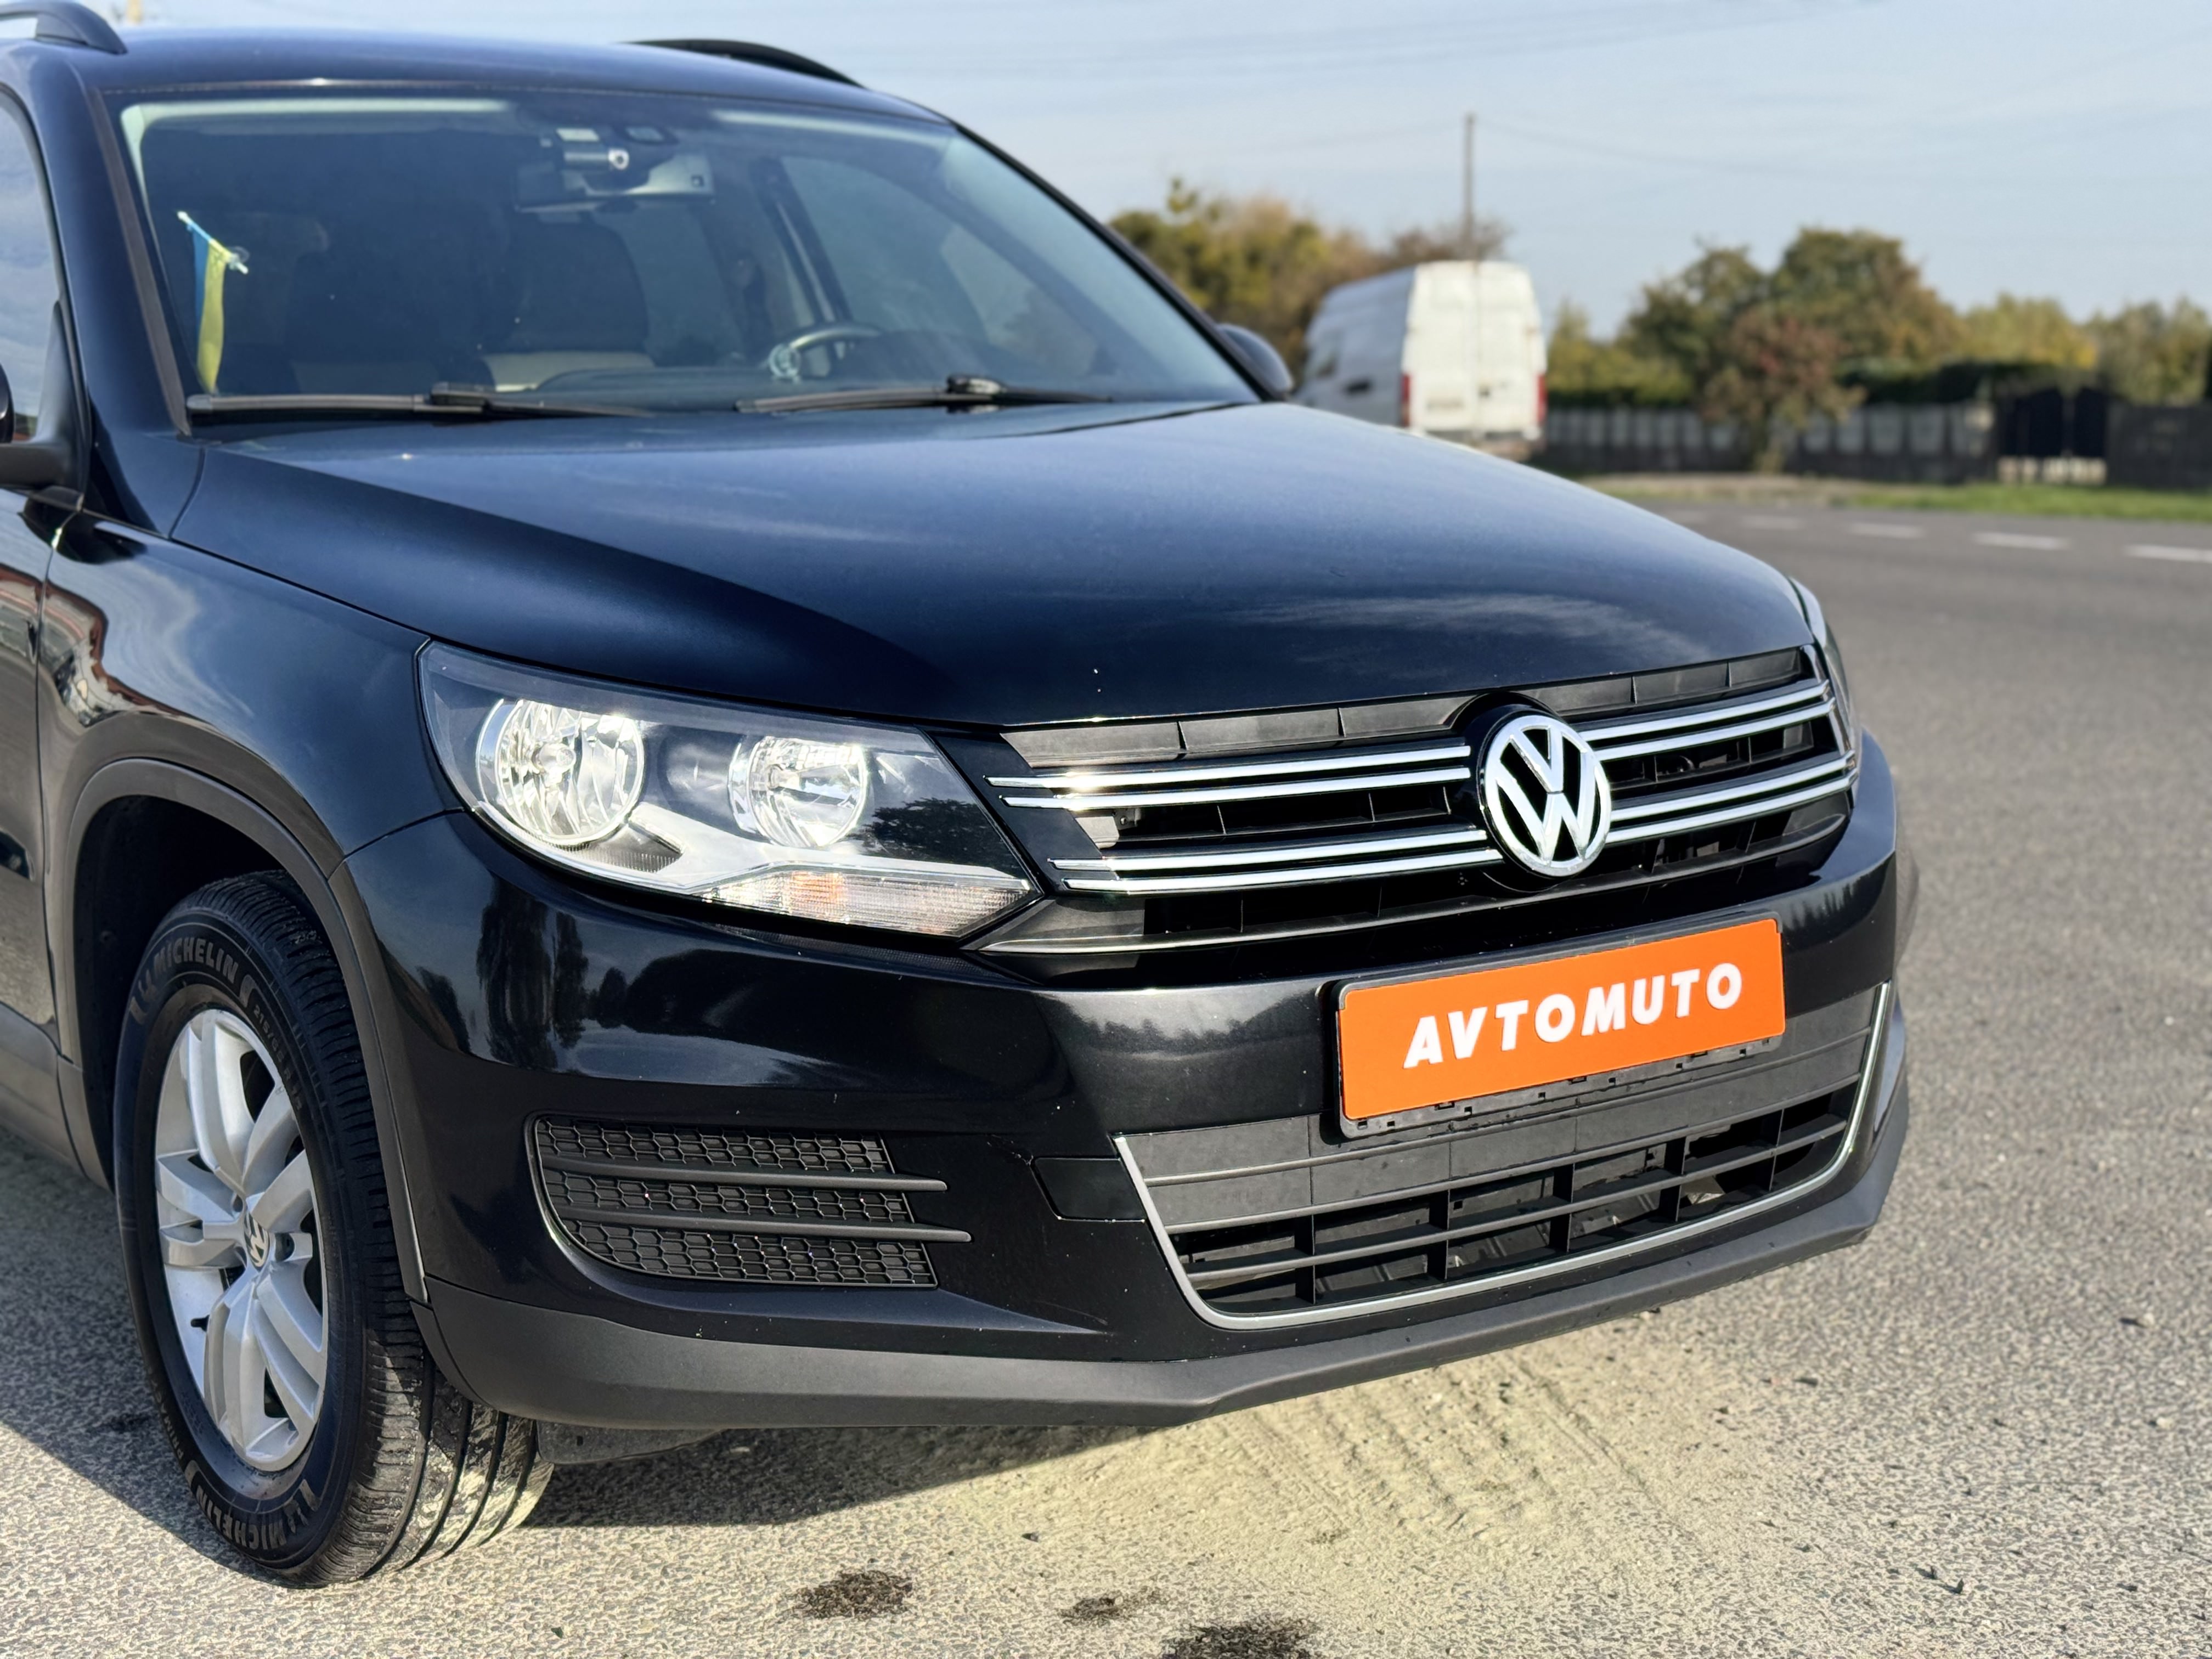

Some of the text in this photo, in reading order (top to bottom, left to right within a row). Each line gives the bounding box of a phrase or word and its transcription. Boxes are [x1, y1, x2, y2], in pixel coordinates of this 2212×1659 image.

[1485, 715, 1610, 876] VW
[153, 937, 239, 984] MICHELIN
[1403, 962, 1742, 1069] AVTOMUTO
[195, 1484, 287, 1550] MICHELIN
